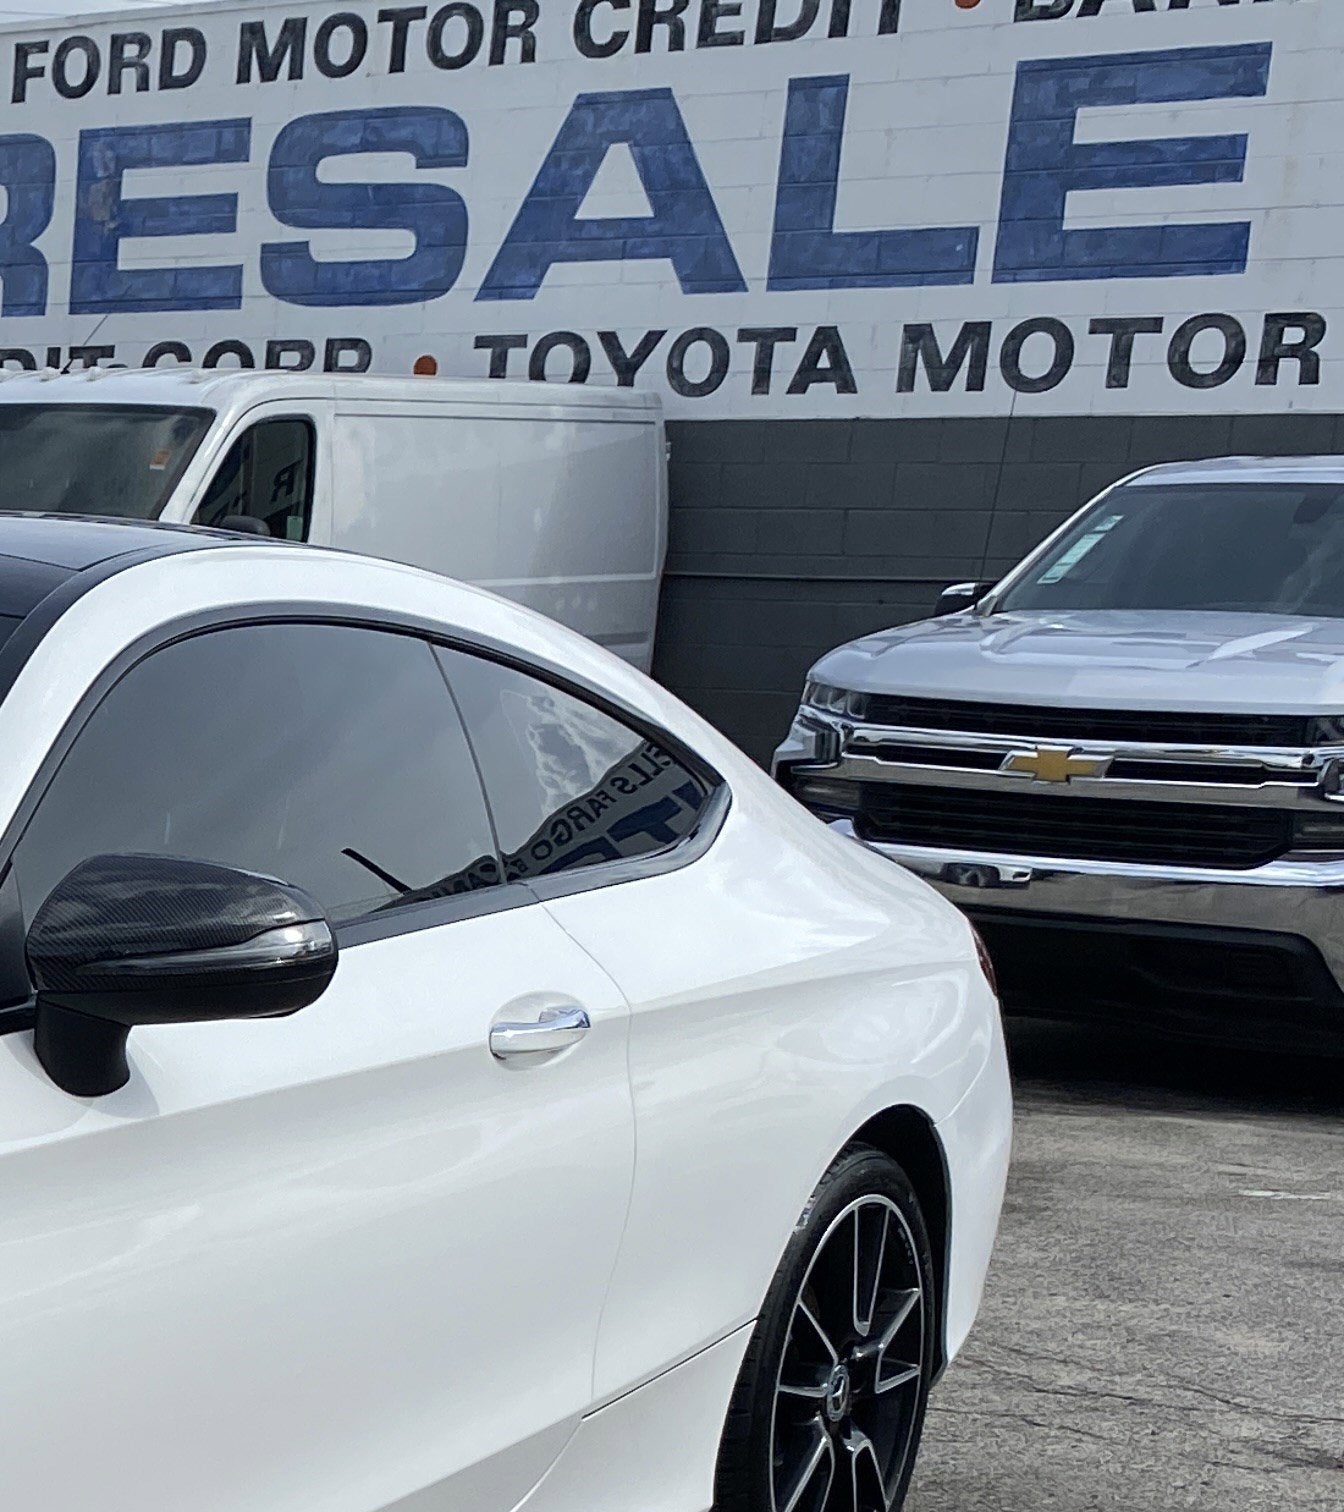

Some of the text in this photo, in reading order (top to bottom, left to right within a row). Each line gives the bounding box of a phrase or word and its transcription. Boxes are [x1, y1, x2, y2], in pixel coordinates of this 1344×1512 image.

[11, 27, 208, 104] FORD
[235, 0, 541, 85] MOTOR
[473, 325, 858, 398] TOYOTA
[896, 312, 1328, 394] MOTOR
